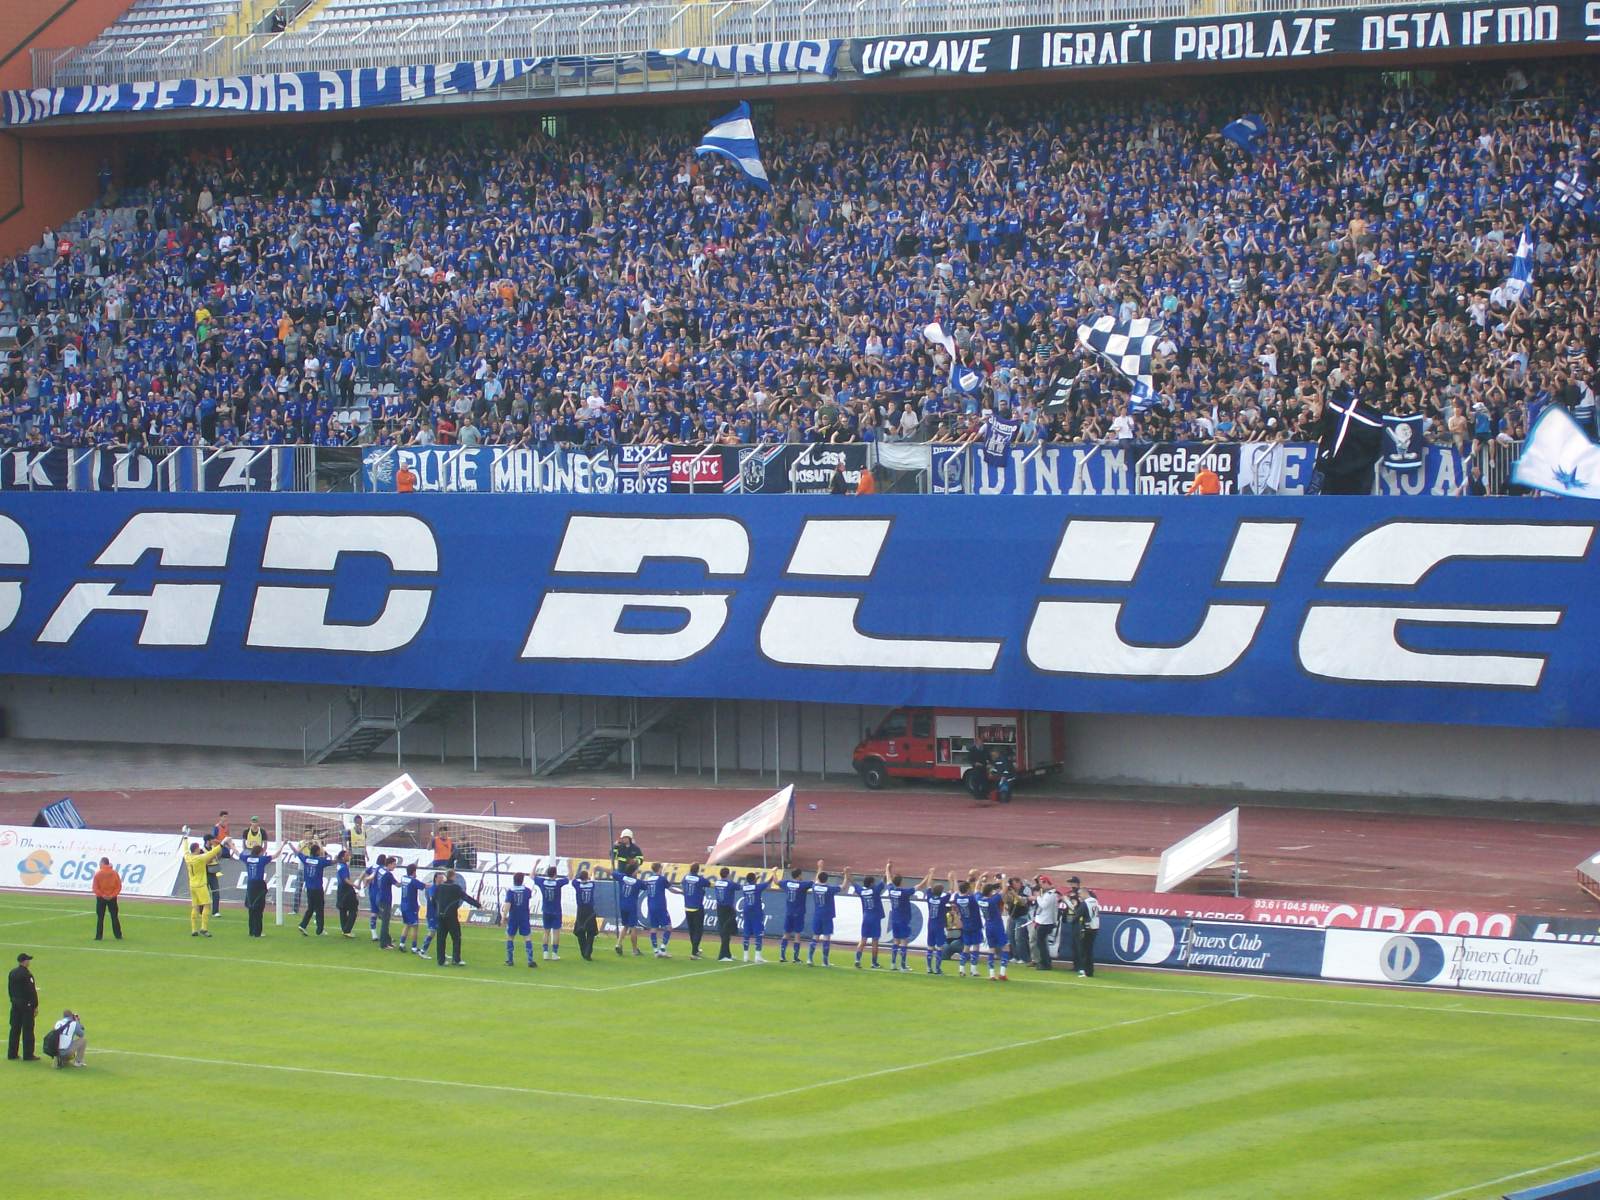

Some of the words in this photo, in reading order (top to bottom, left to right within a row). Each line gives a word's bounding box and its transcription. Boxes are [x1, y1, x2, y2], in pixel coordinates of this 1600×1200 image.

[862, 38, 991, 74] UPRAVE
[1010, 35, 1020, 70] I
[1175, 18, 1337, 61] PROLAZE
[0, 512, 440, 654] AD
[520, 513, 1596, 688] BLUE
[1179, 927, 1227, 950] Diners
[1228, 932, 1263, 951] Club
[1177, 944, 1268, 969] International
[1452, 945, 1500, 964] Diners
[1503, 947, 1539, 966] Club
[1450, 966, 1544, 986] International
